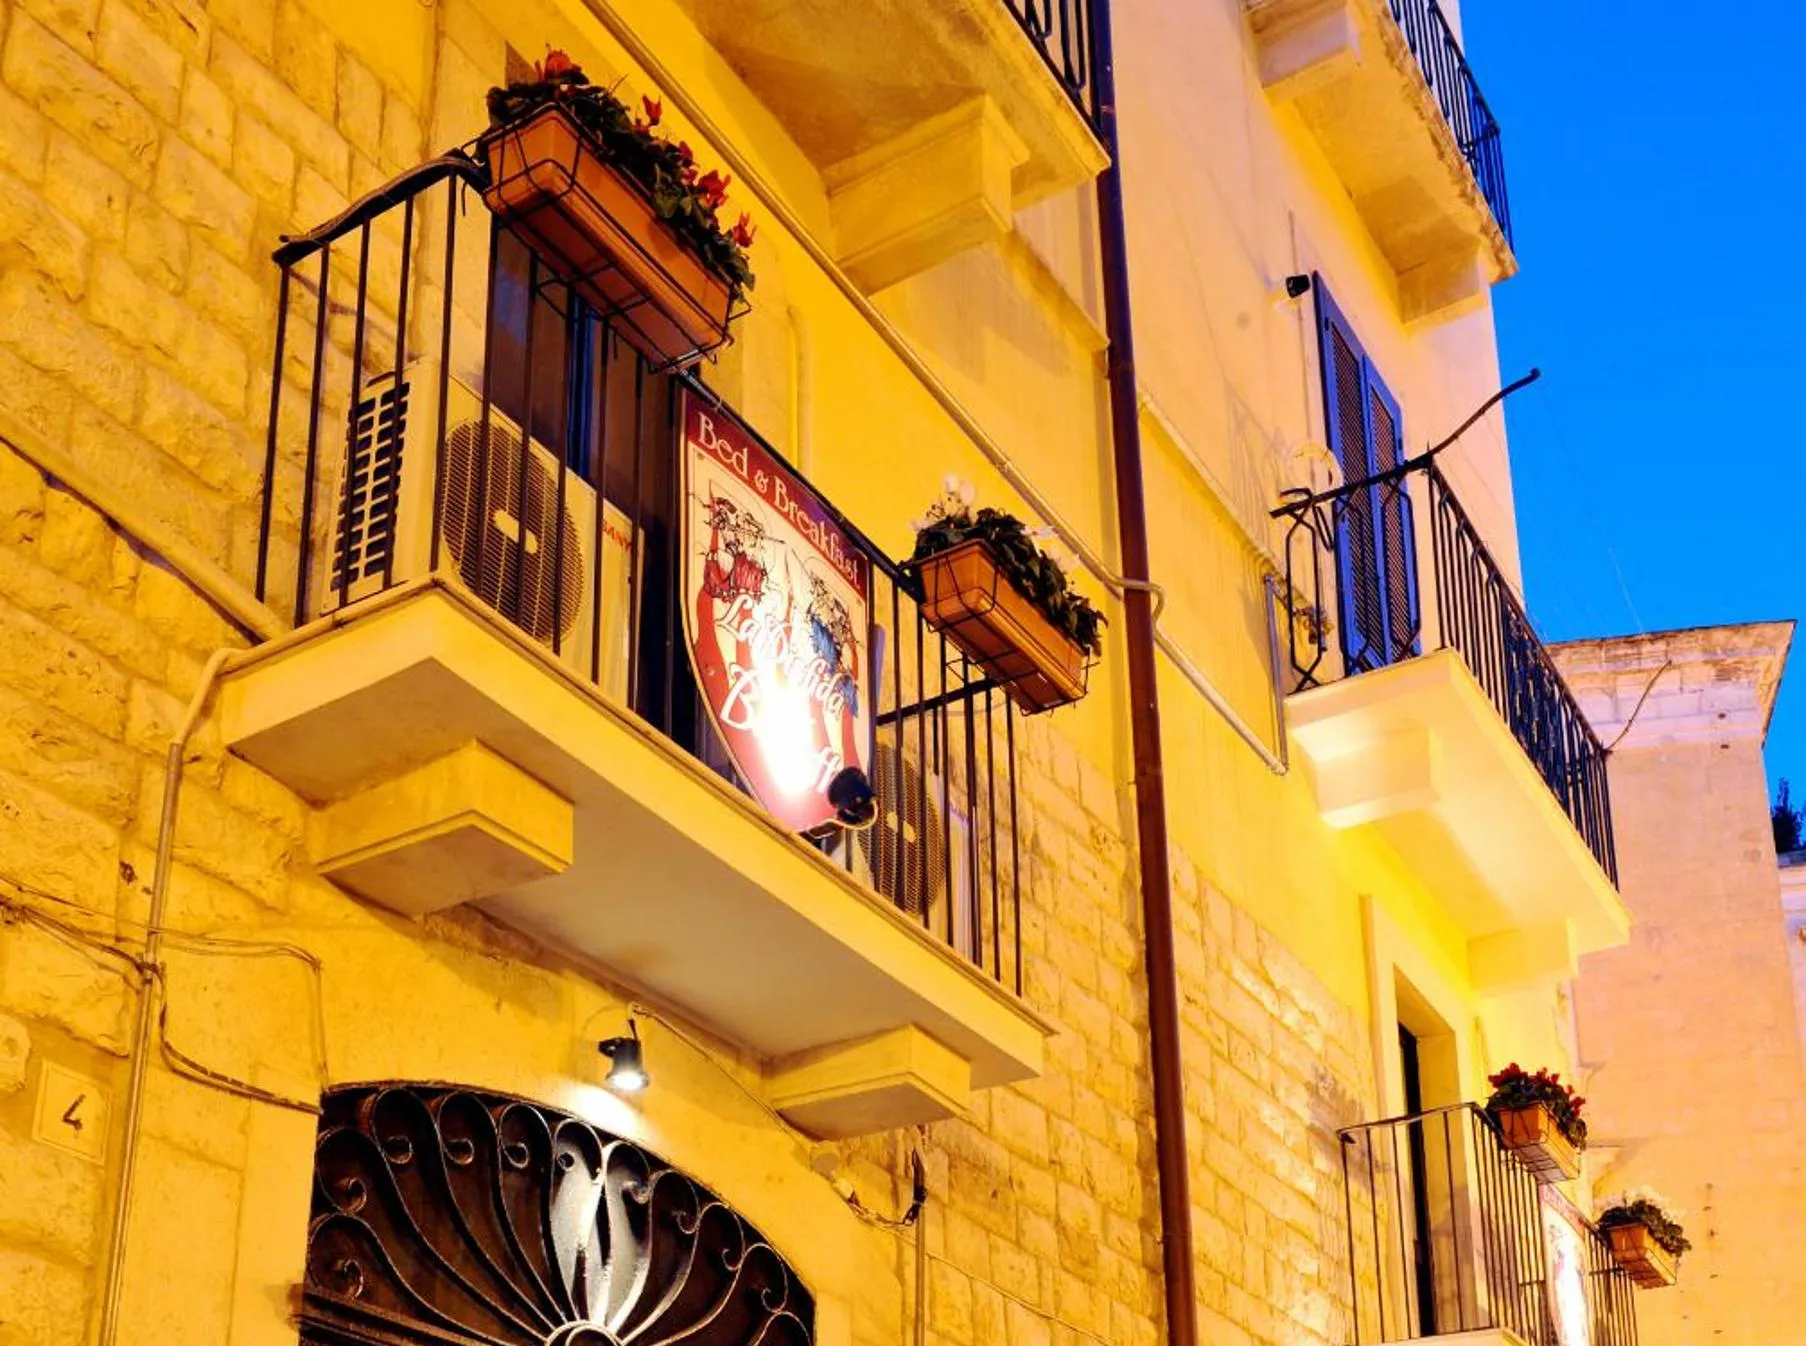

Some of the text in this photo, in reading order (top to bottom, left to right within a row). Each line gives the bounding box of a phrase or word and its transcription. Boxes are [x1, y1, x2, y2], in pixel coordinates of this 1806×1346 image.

[698, 412, 861, 592] Bed & Breakfast
